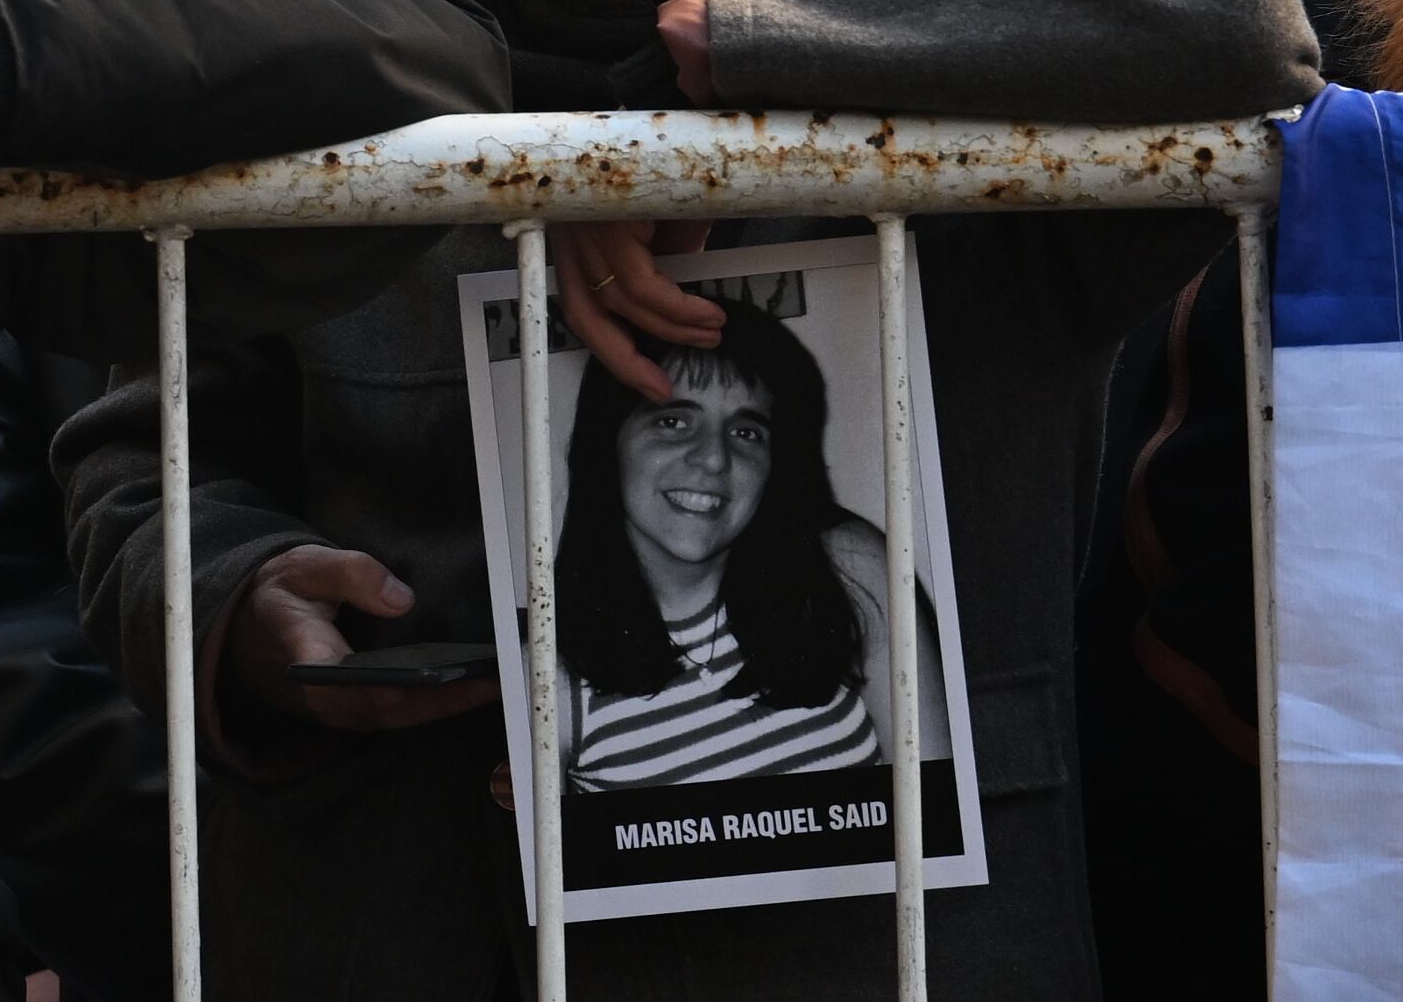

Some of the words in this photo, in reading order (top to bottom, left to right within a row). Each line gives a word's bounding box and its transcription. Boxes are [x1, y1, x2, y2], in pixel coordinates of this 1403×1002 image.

[615, 817, 717, 850] MARISA
[722, 807, 823, 840] RAQUEL
[828, 801, 888, 830] SAID
